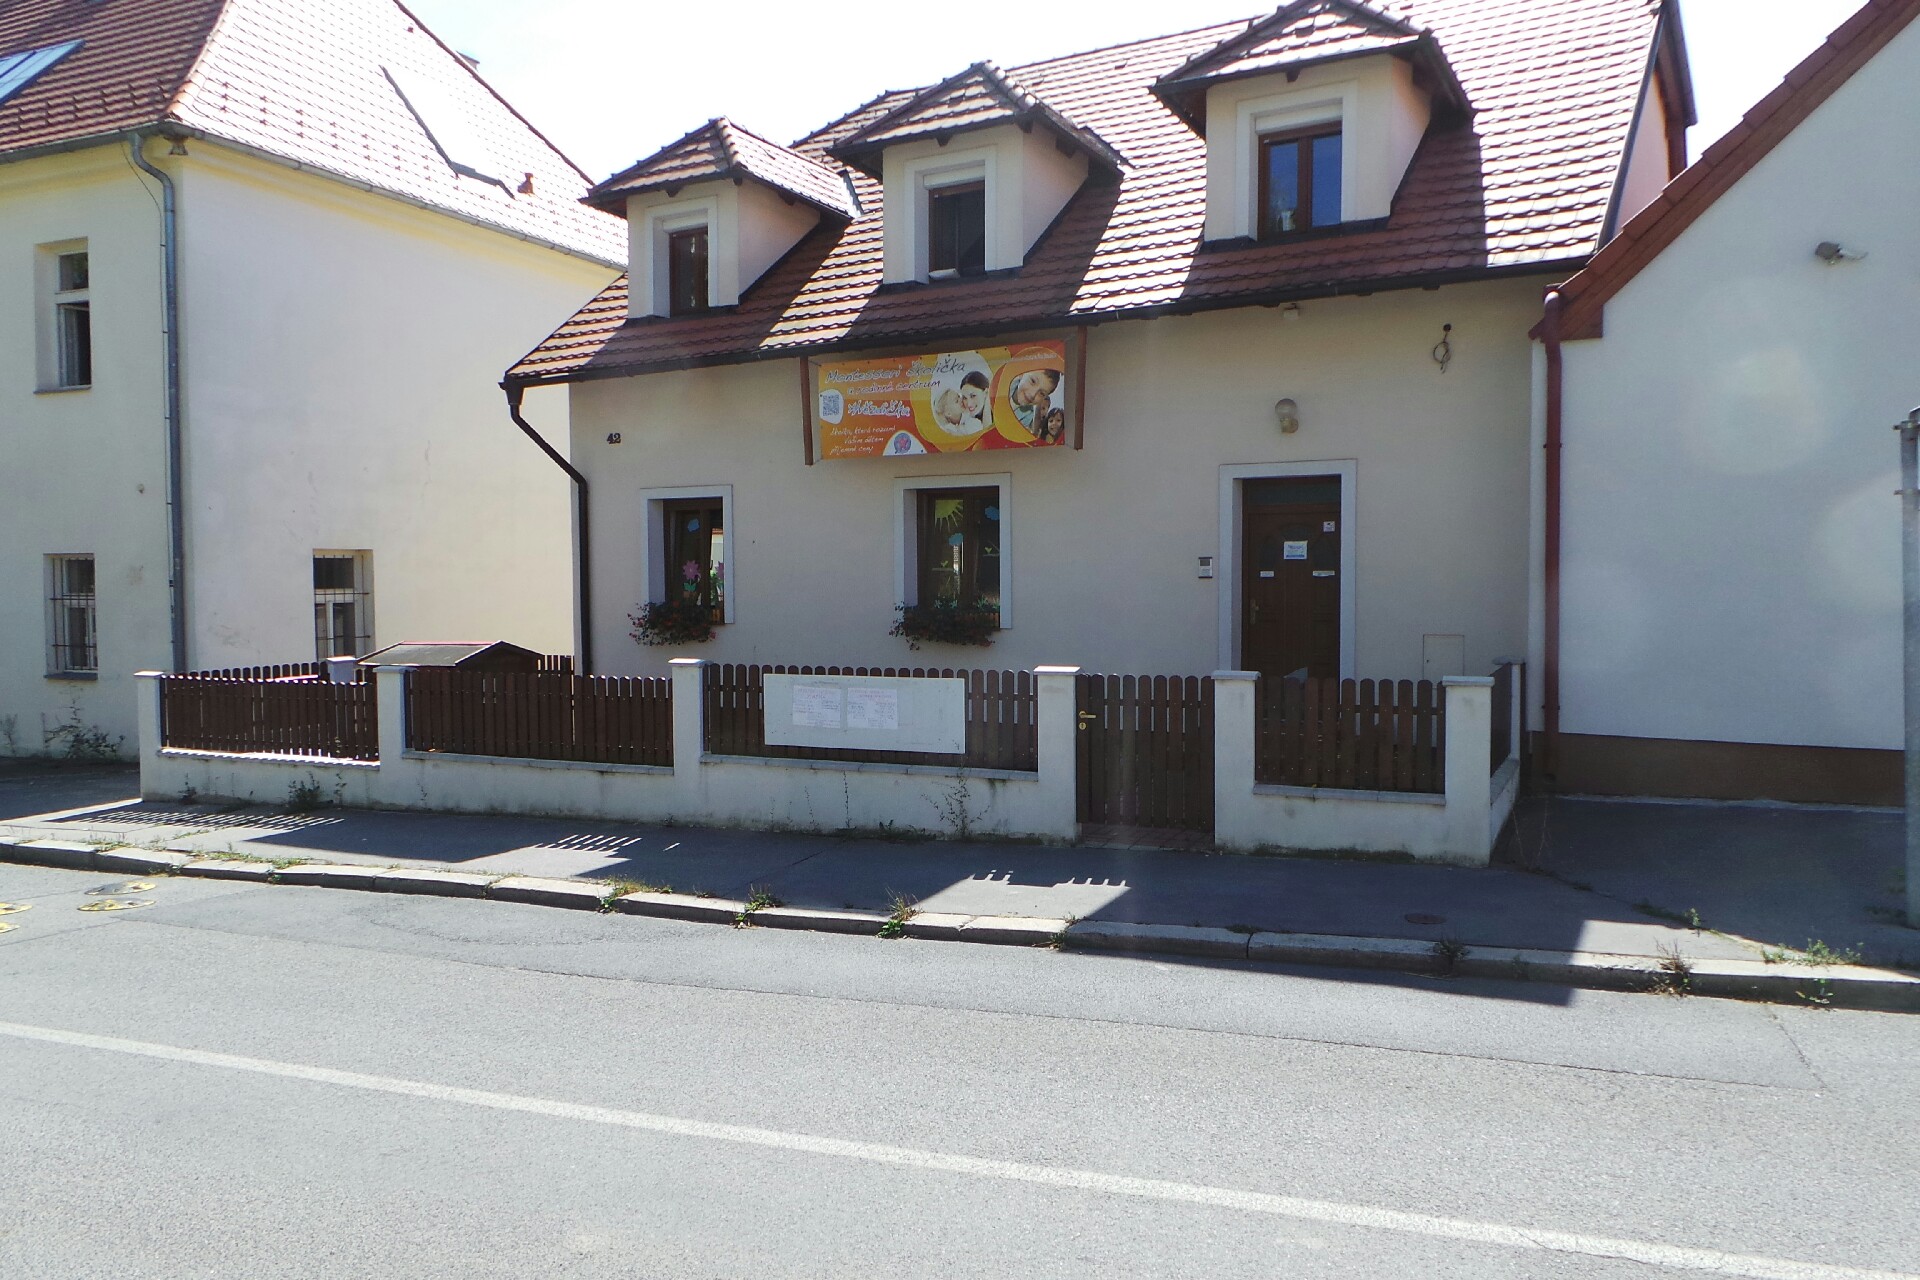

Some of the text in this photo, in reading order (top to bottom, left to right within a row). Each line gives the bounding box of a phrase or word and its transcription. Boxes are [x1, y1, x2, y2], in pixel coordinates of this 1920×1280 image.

[825, 358, 966, 383] Montessori Školička
[856, 380, 894, 394] rodinné
[896, 379, 941, 391] centrum
[606, 432, 622, 445] 42
